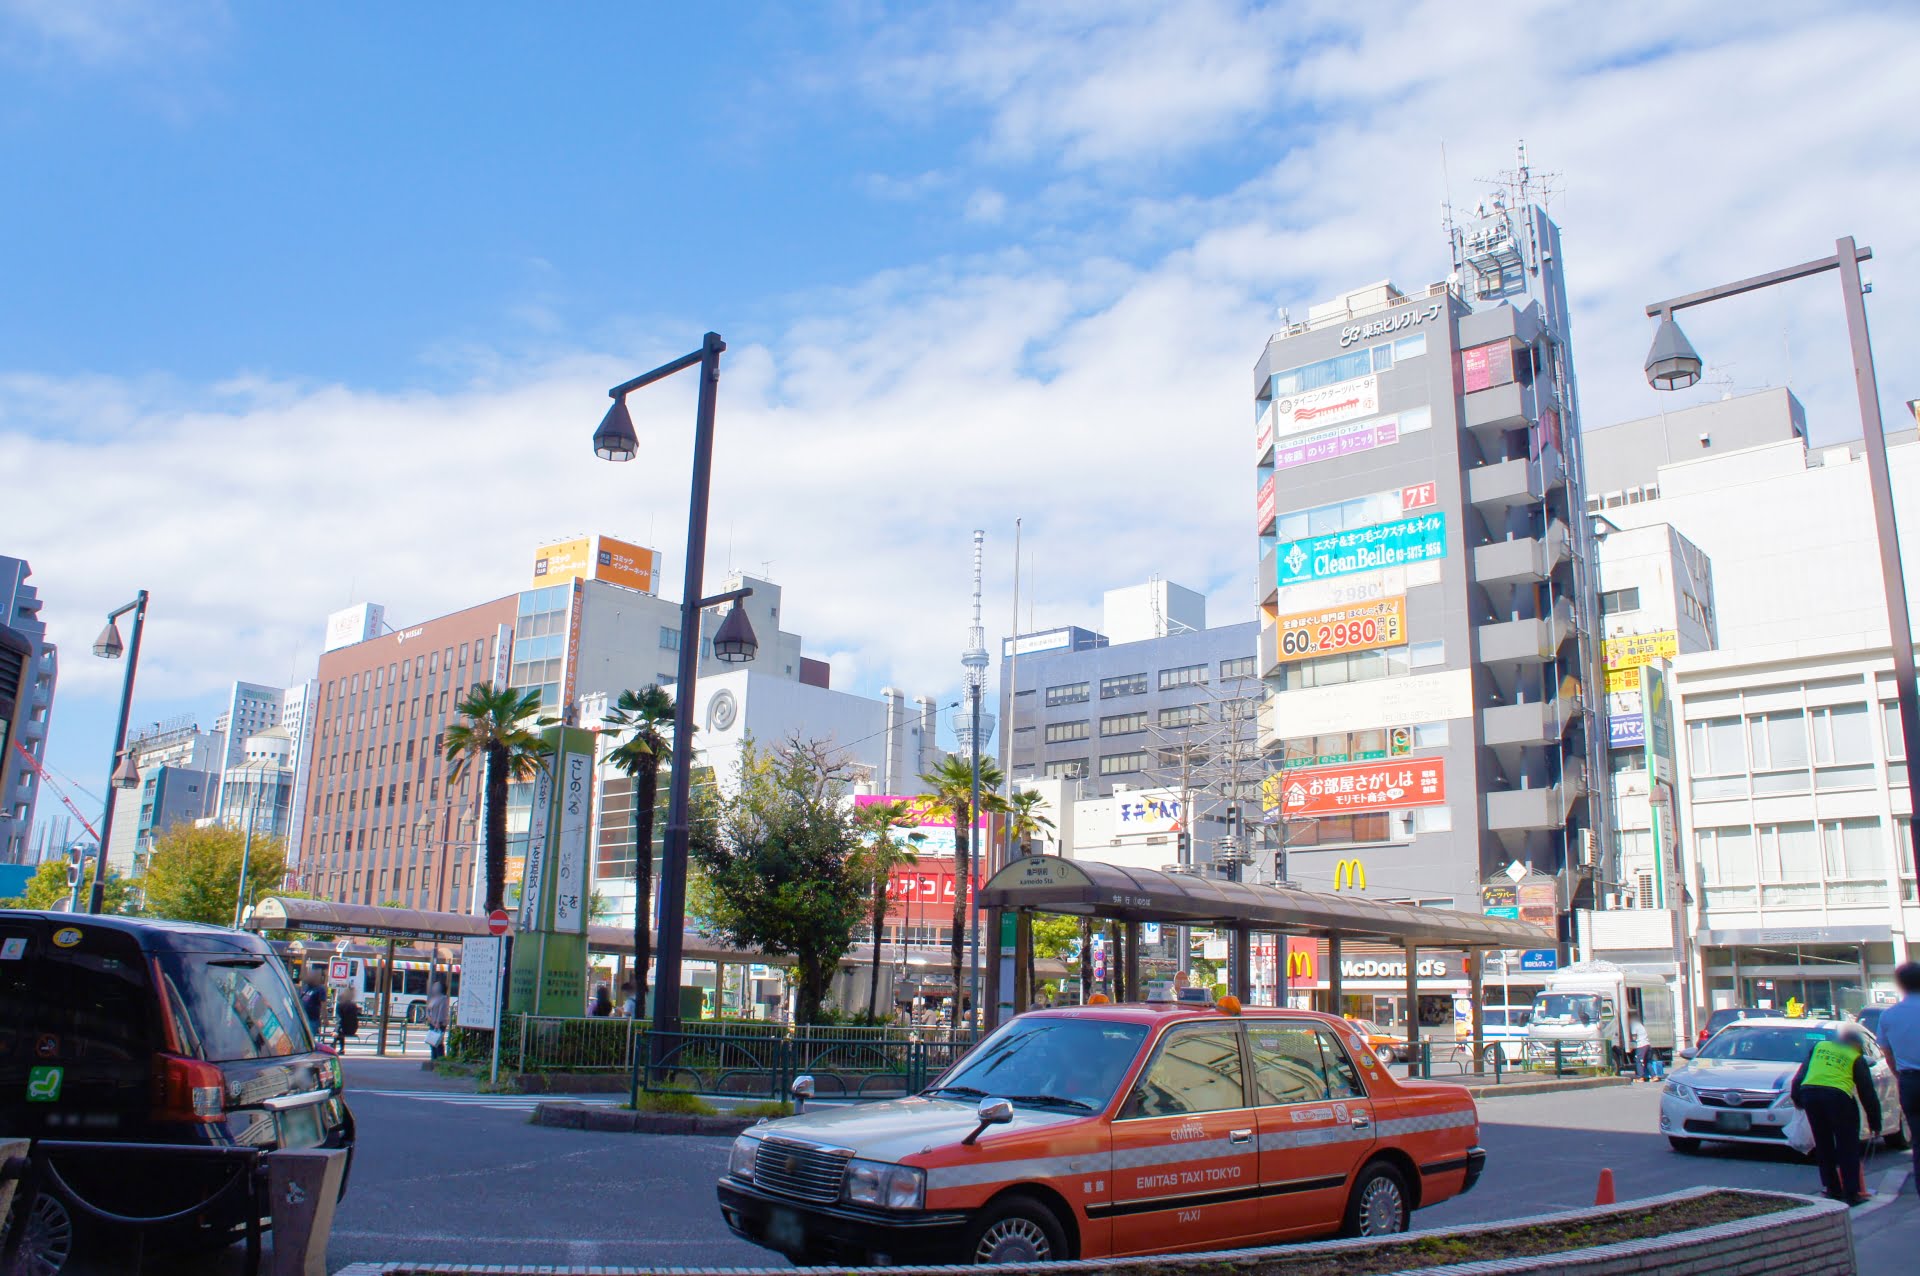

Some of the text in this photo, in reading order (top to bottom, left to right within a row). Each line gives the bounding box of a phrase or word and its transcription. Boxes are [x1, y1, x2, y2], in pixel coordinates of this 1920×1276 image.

[1406, 486, 1430, 510] 7F
[613, 554, 634, 565] コミック
[613, 562, 649, 577] インターネット
[567, 758, 584, 816] さしのべる
[1309, 770, 1414, 796] お部屋さがしは
[1335, 791, 1387, 805] モリモト商会
[1136, 1166, 1241, 1189] EMITAS TAXI TOKYO
[1177, 1209, 1201, 1224] TAXI
